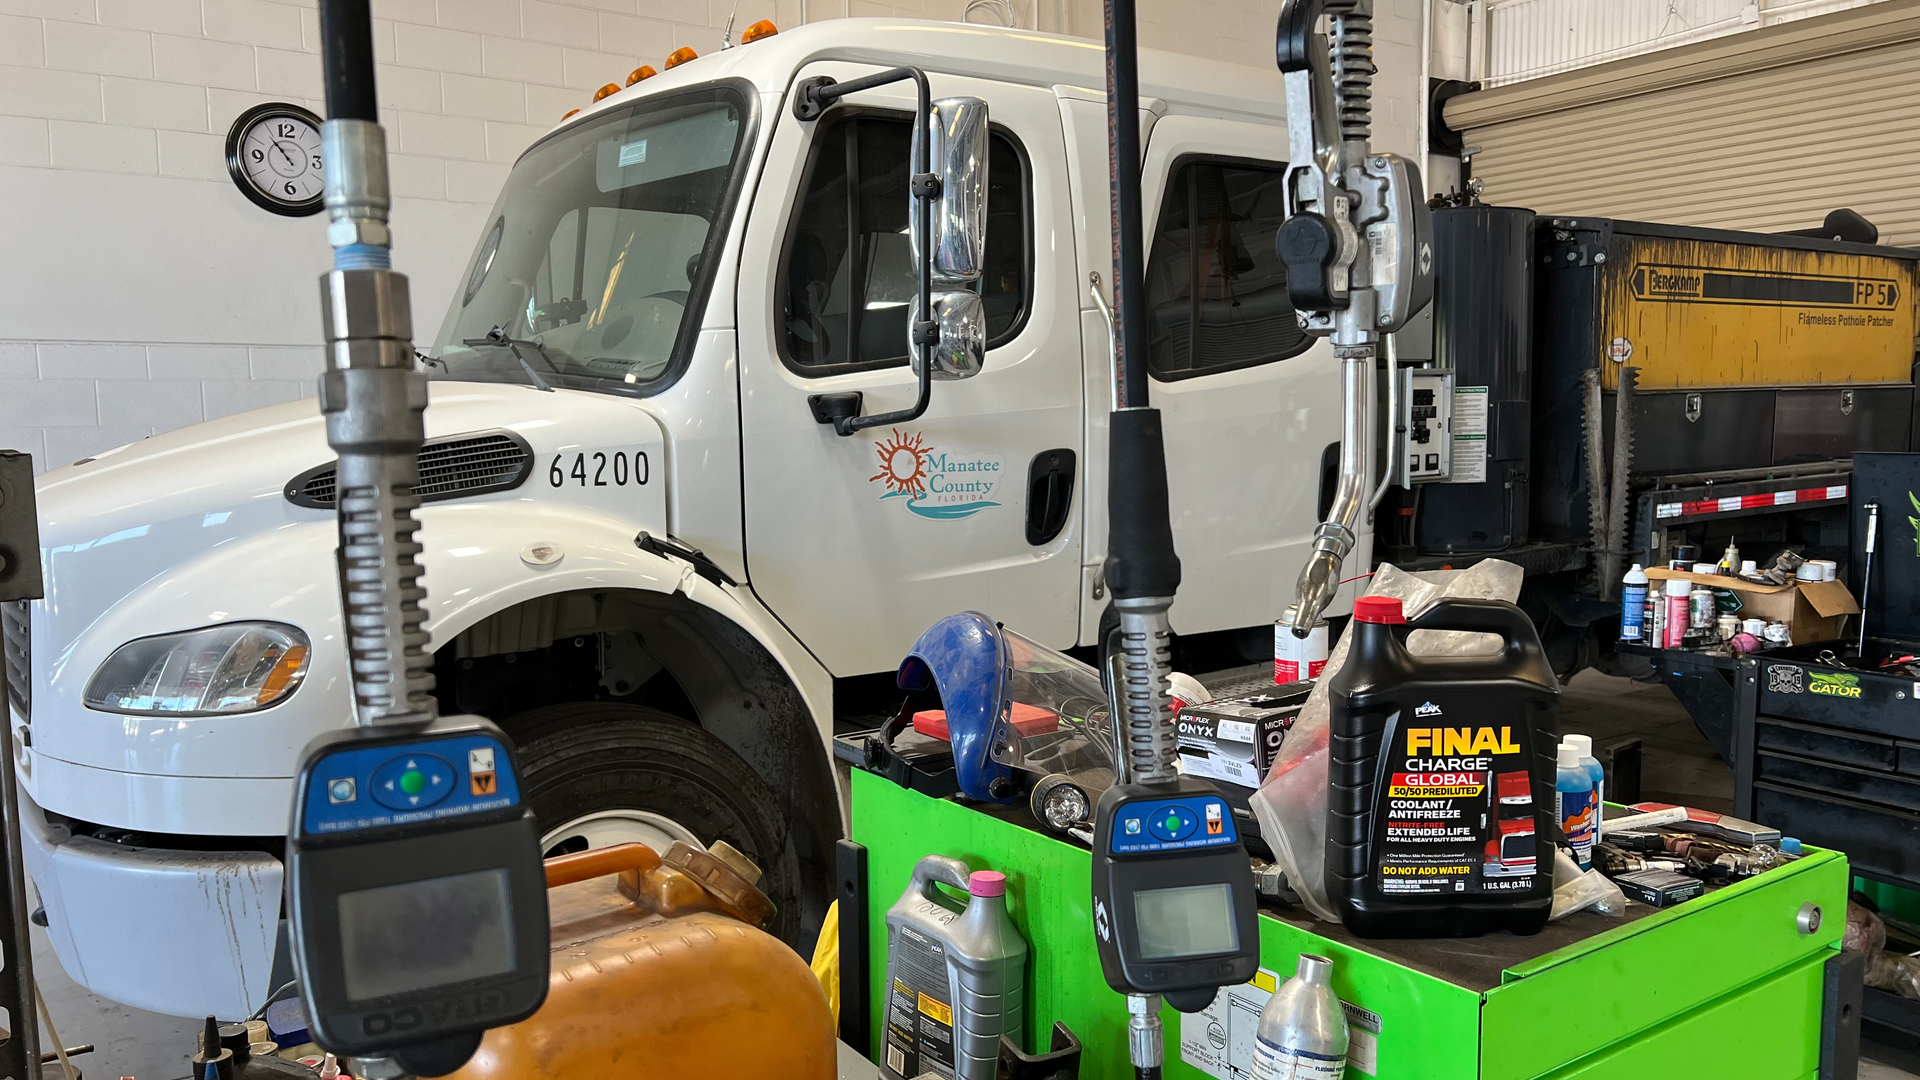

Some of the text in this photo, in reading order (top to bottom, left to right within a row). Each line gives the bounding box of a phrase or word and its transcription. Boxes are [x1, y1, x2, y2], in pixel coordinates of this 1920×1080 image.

[277, 124, 295, 139] 12
[251, 149, 264, 163] 9
[312, 155, 322, 170] 3
[1109, 145, 1118, 183] MSHA
[284, 181, 296, 195] 6
[1111, 235, 1121, 260] SAE
[1650, 270, 1701, 294] BERGKAMP
[1856, 282, 1886, 306] FP 5
[1798, 312, 1894, 327] Flameless Pothole Patcher
[549, 451, 649, 488] 64200
[925, 453, 1000, 473] Manatee
[929, 474, 994, 494] County
[1771, 674, 1801, 685] 19 19
[1809, 681, 1861, 697] GATOR
[1415, 704, 1441, 714] PEAK
[1180, 714, 1210, 724] MICROFLEX
[1178, 722, 1215, 737] ONYX
[1407, 726, 1520, 756] FINAL
[1405, 773, 1479, 785] GLOBAL
[1394, 786, 1478, 797] 50/50 PREDILUTED
[435, 804, 470, 818] WORKING
[472, 798, 511, 811] MAXIMUM
[1390, 800, 1446, 809] COOLANT
[393, 810, 434, 823] PRESSURE
[1388, 810, 1461, 819] ANTIFREEZE
[1387, 827, 1470, 836] EXTENDED LIFE
[1161, 841, 1185, 849] PRESSURE
[1185, 839, 1207, 847] WORKING
[1207, 836, 1231, 844] MAXIMUM
[1383, 866, 1470, 875] DO NOT ADD WATER
[1500, 881, 1511, 889] GAL
[1511, 881, 1526, 890] (3.78
[1181, 1048, 1214, 1067] FRONT AND BACK
[1182, 1042, 1214, 1060] SUPPORT BLOCK
